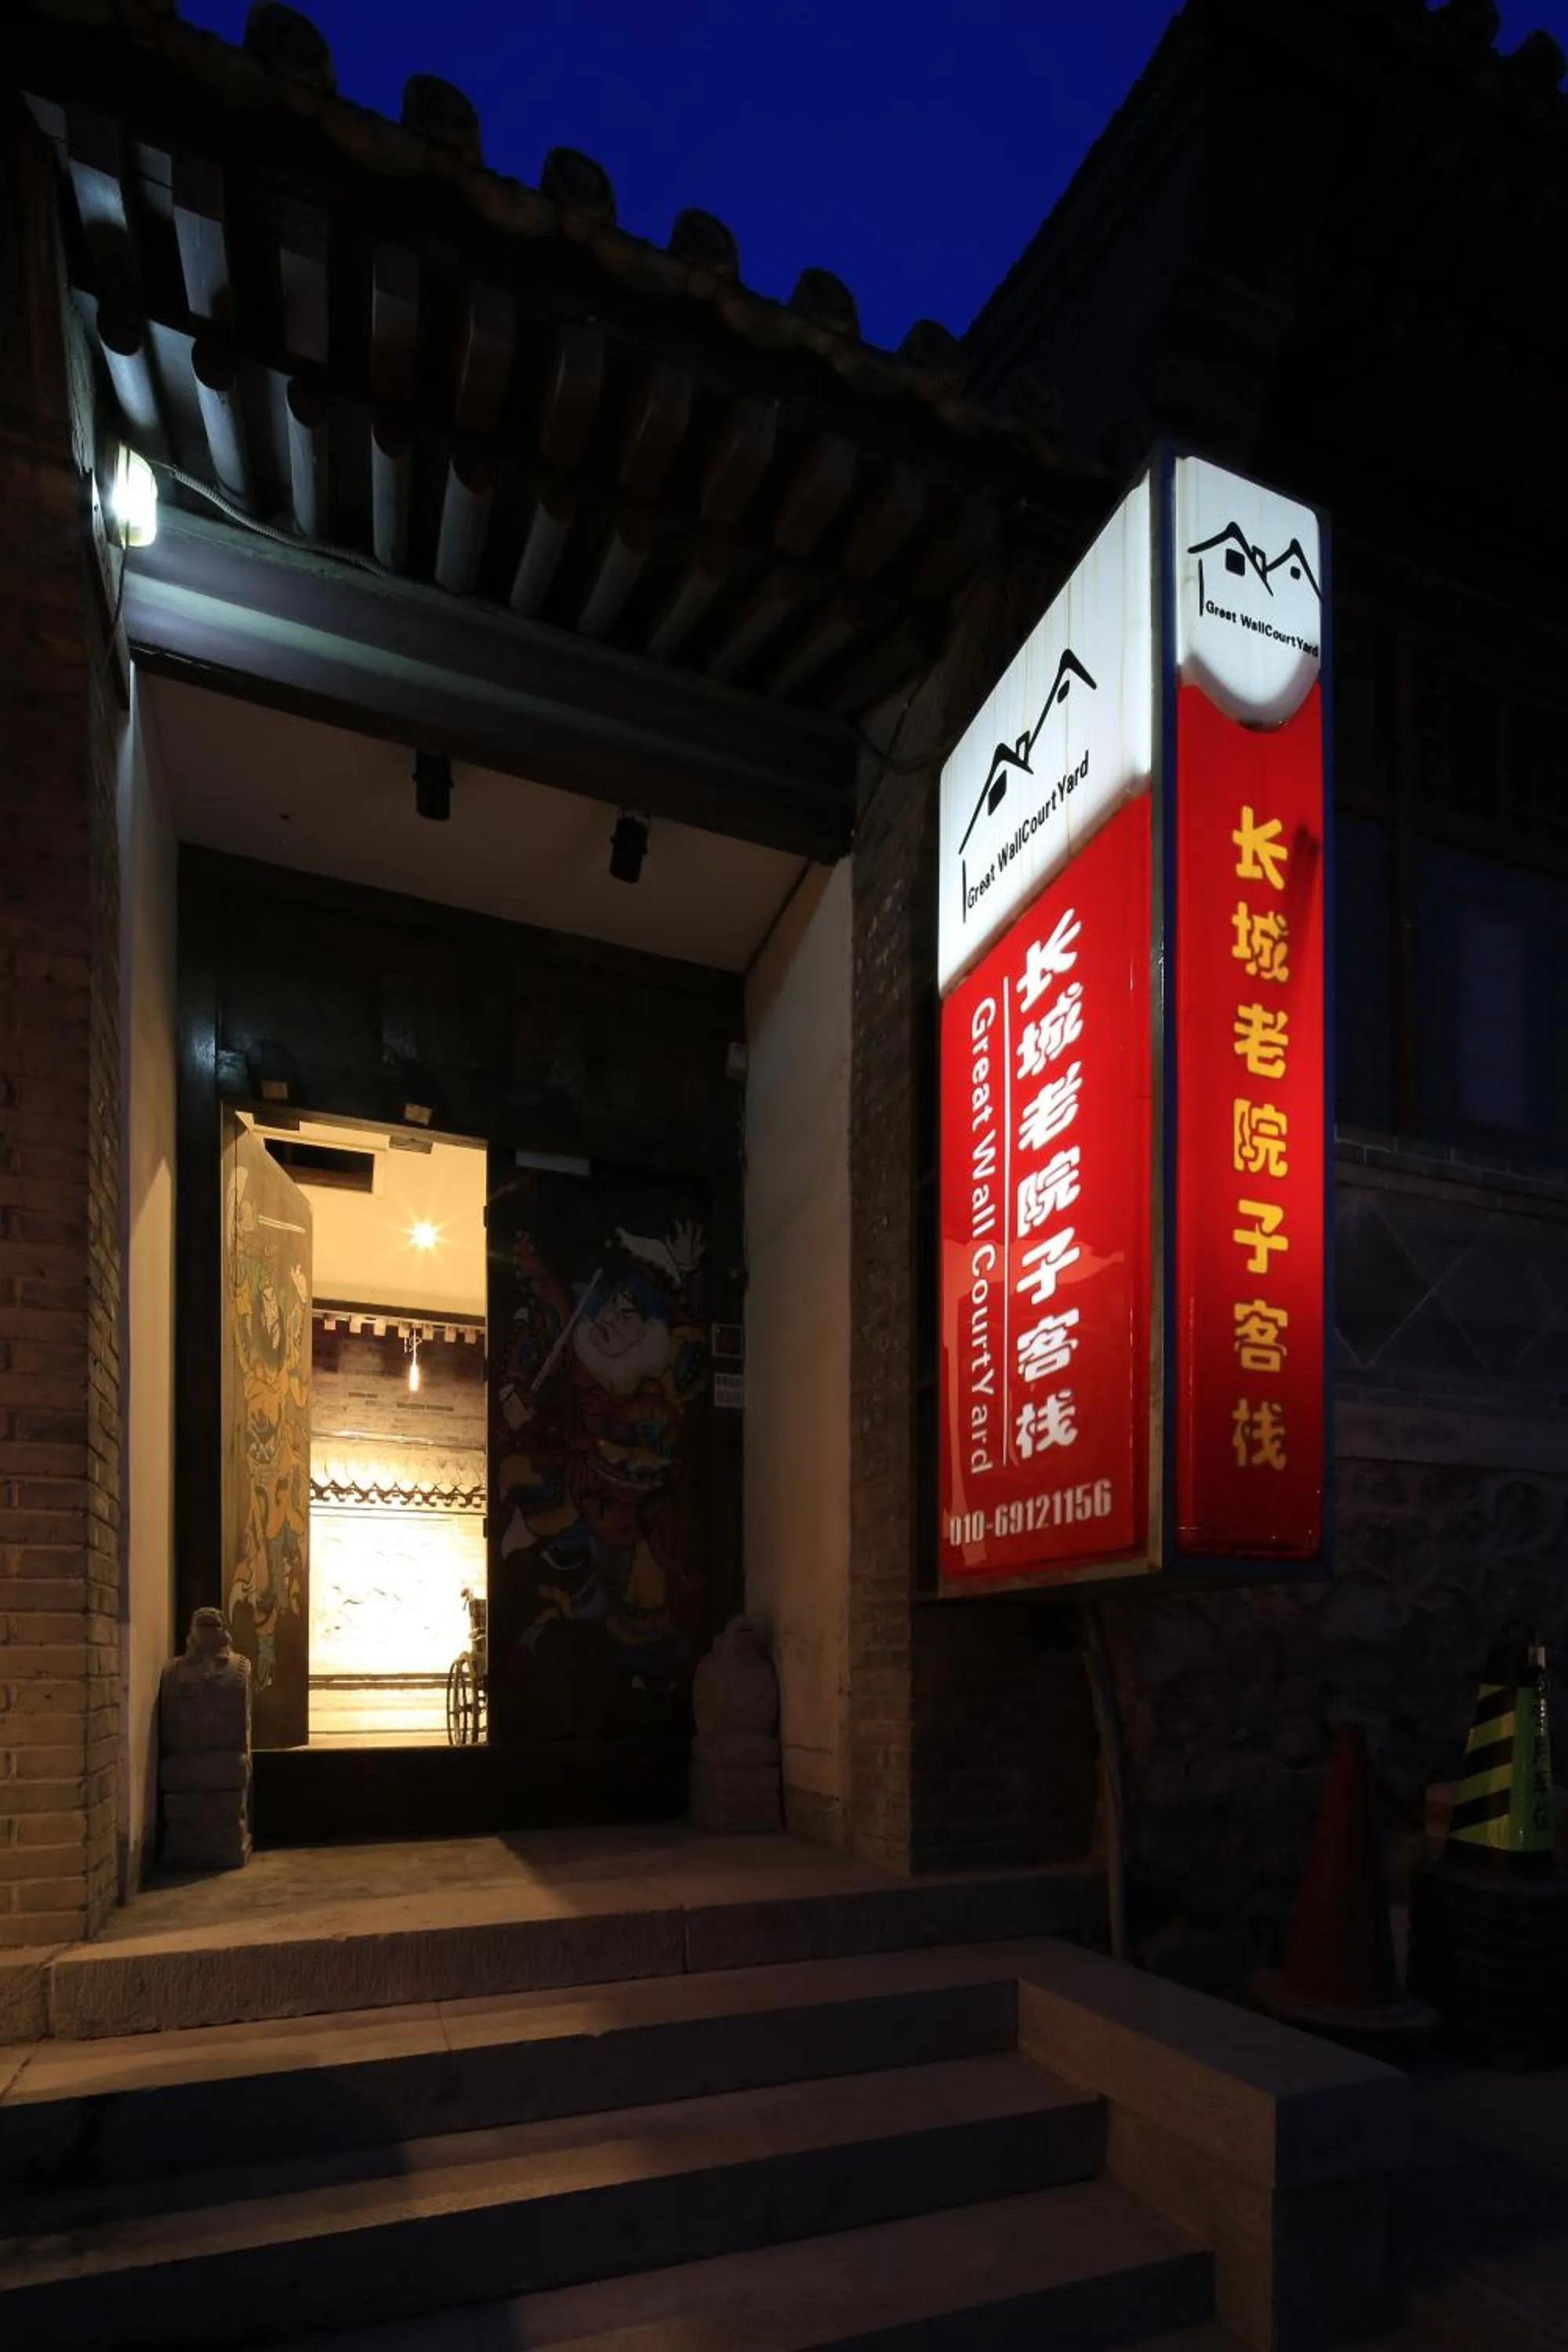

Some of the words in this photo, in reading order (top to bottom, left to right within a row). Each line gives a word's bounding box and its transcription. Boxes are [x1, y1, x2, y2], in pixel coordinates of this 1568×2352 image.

[1206, 601, 1236, 622] Great
[967, 864, 995, 908] Great
[971, 996, 996, 1132] Great
[1017, 908, 1083, 1459] 长城老院子客栈
[1232, 805, 1290, 1471] 长城老院子客栈
[949, 1477, 1112, 1547] 010-69121156
